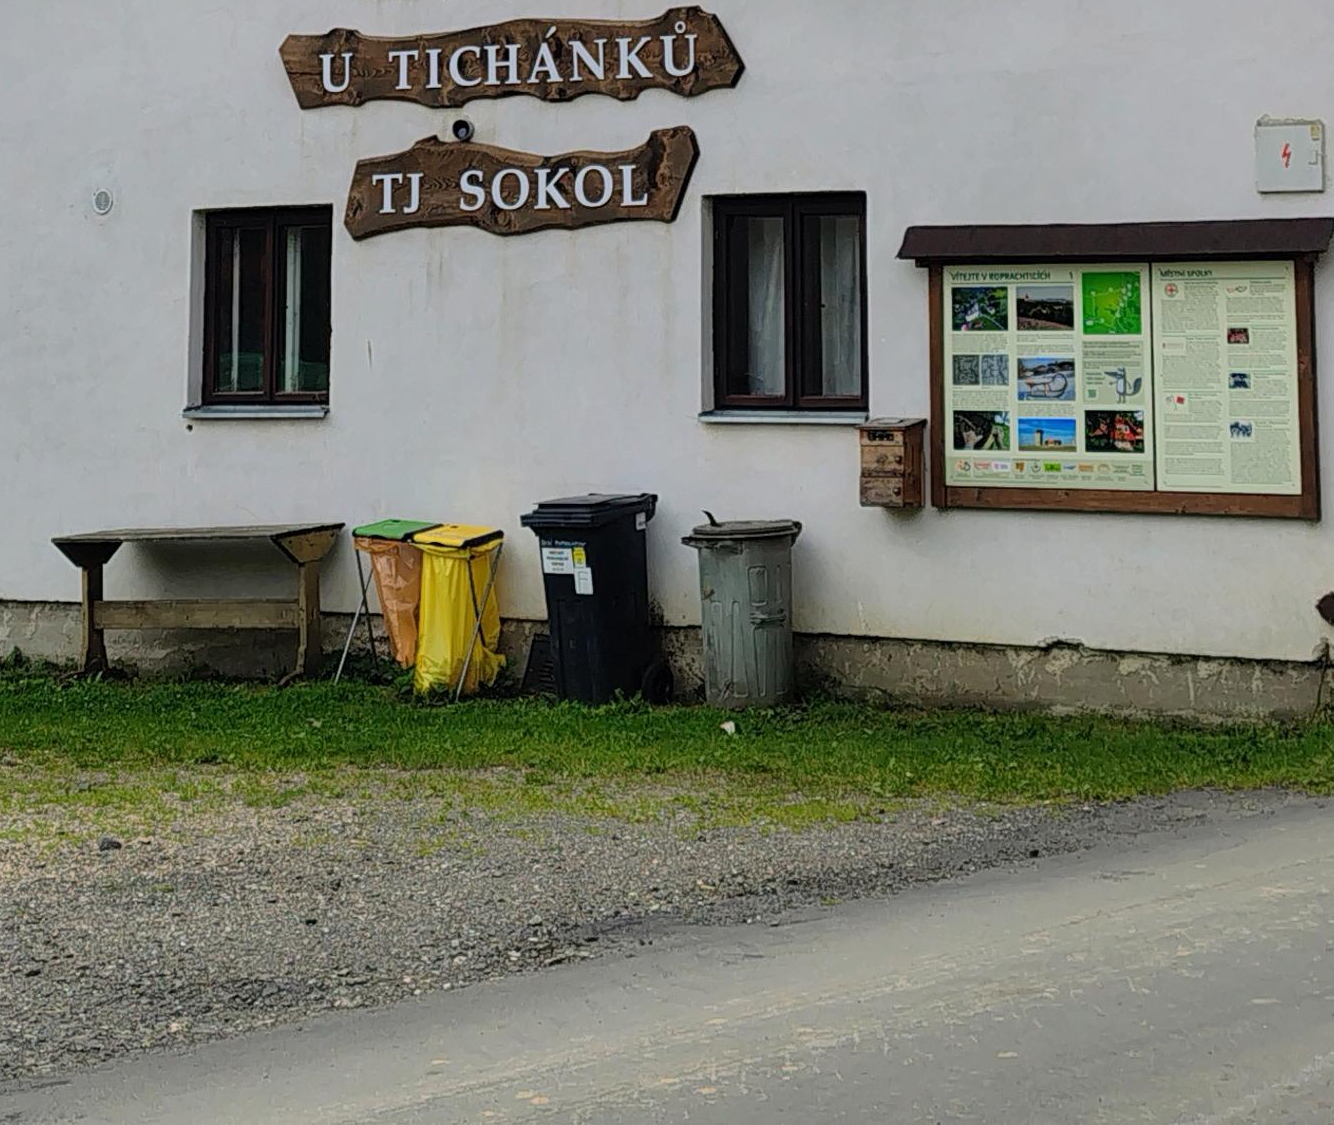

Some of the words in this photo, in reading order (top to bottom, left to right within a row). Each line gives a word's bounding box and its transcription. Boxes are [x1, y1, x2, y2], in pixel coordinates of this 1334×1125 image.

[319, 53, 353, 93] U
[388, 21, 697, 90] TICHÁNKŮ
[372, 173, 423, 214] TJ
[459, 165, 648, 211] SOKOL
